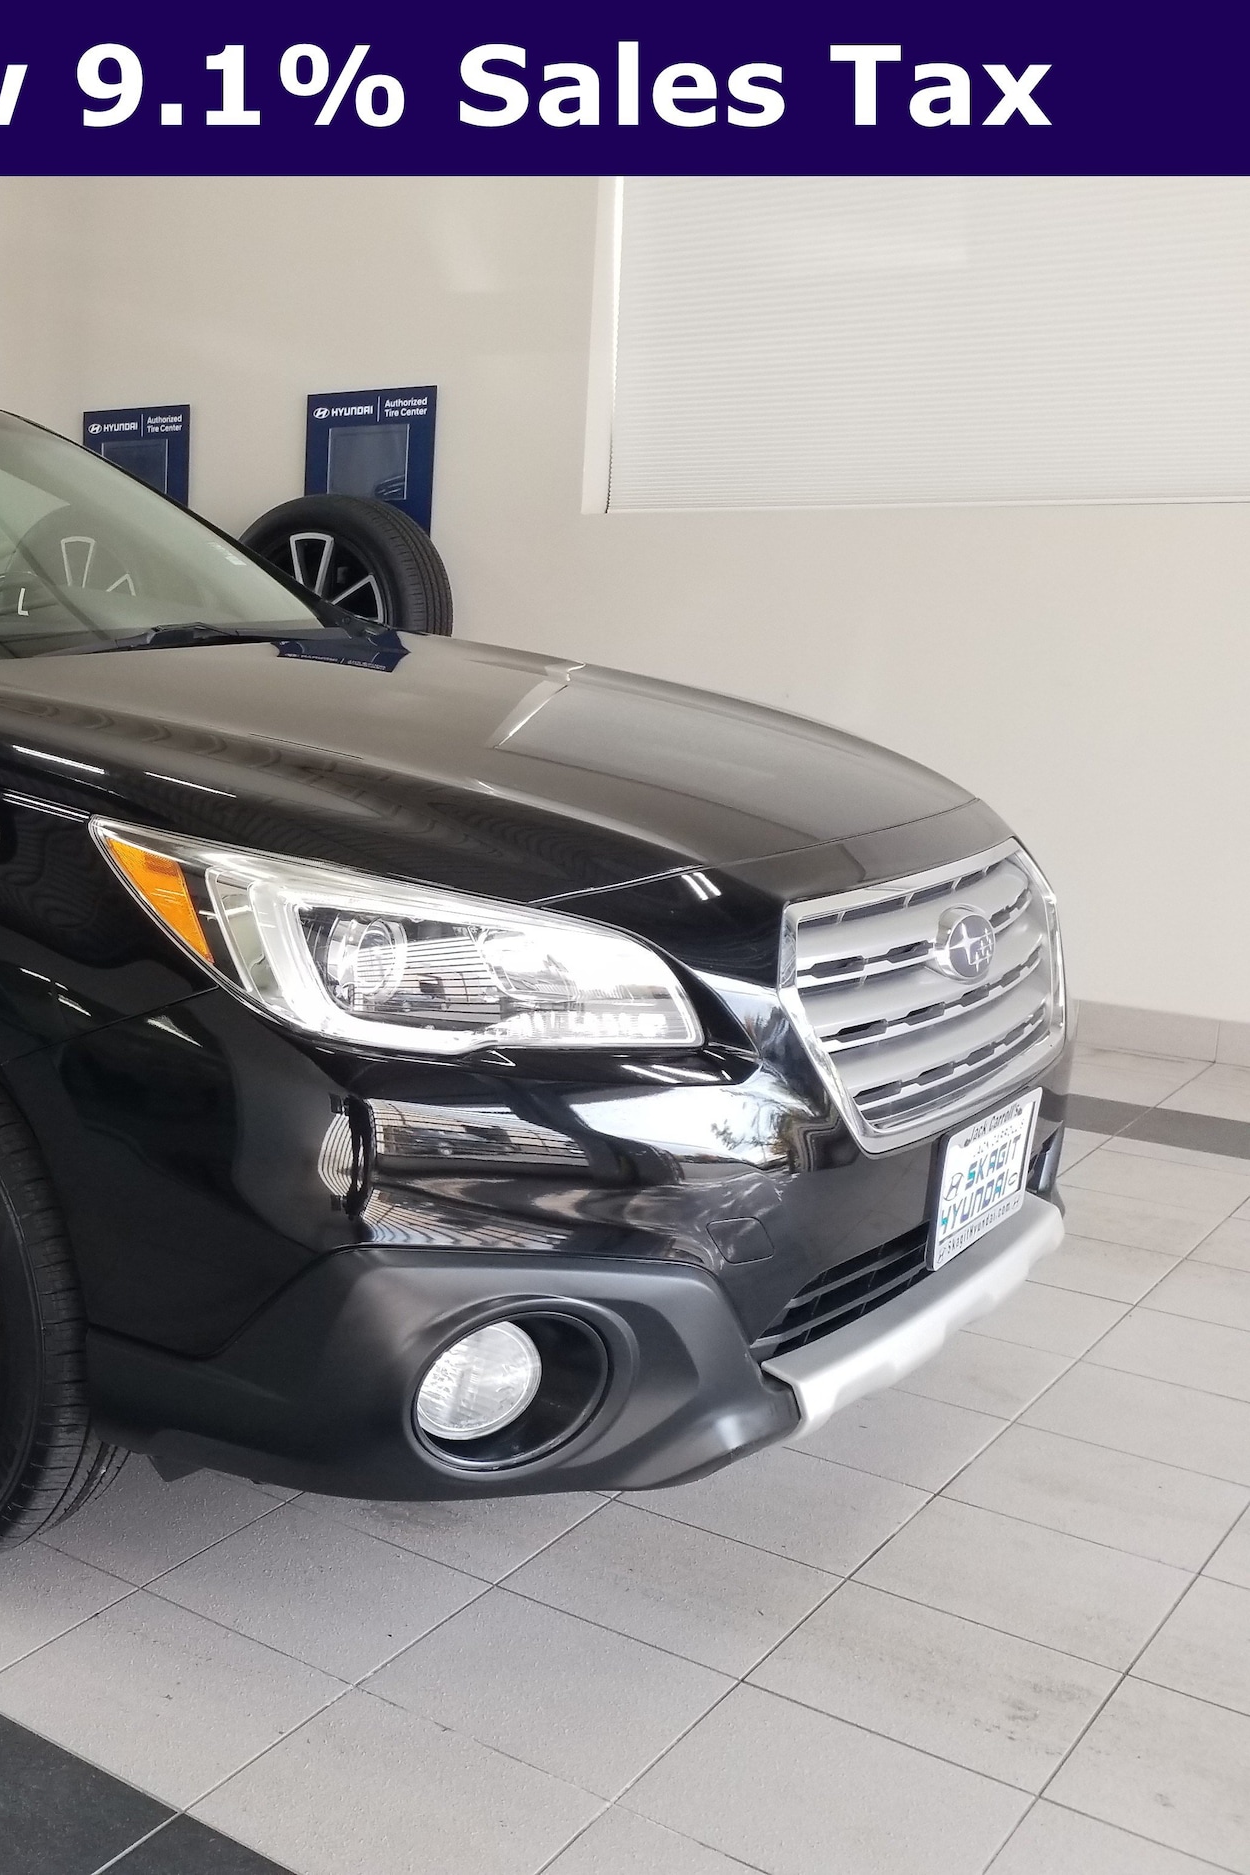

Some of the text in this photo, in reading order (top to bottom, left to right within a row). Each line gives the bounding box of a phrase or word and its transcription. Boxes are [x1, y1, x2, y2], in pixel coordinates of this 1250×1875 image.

[384, 396, 428, 408] Authorized
[331, 405, 374, 417] HYUNDAI
[384, 408, 427, 418] Tire Center
[147, 414, 183, 425] Authorized
[103, 422, 138, 433] HYUNDAI
[147, 424, 183, 434] Tire Center
[969, 1120, 988, 1142] Jack
[964, 1134, 1021, 1191] SKAGIT
[940, 1169, 1009, 1235] HYUNDAI
[946, 1203, 1011, 1255] SkagitHyundai.com
